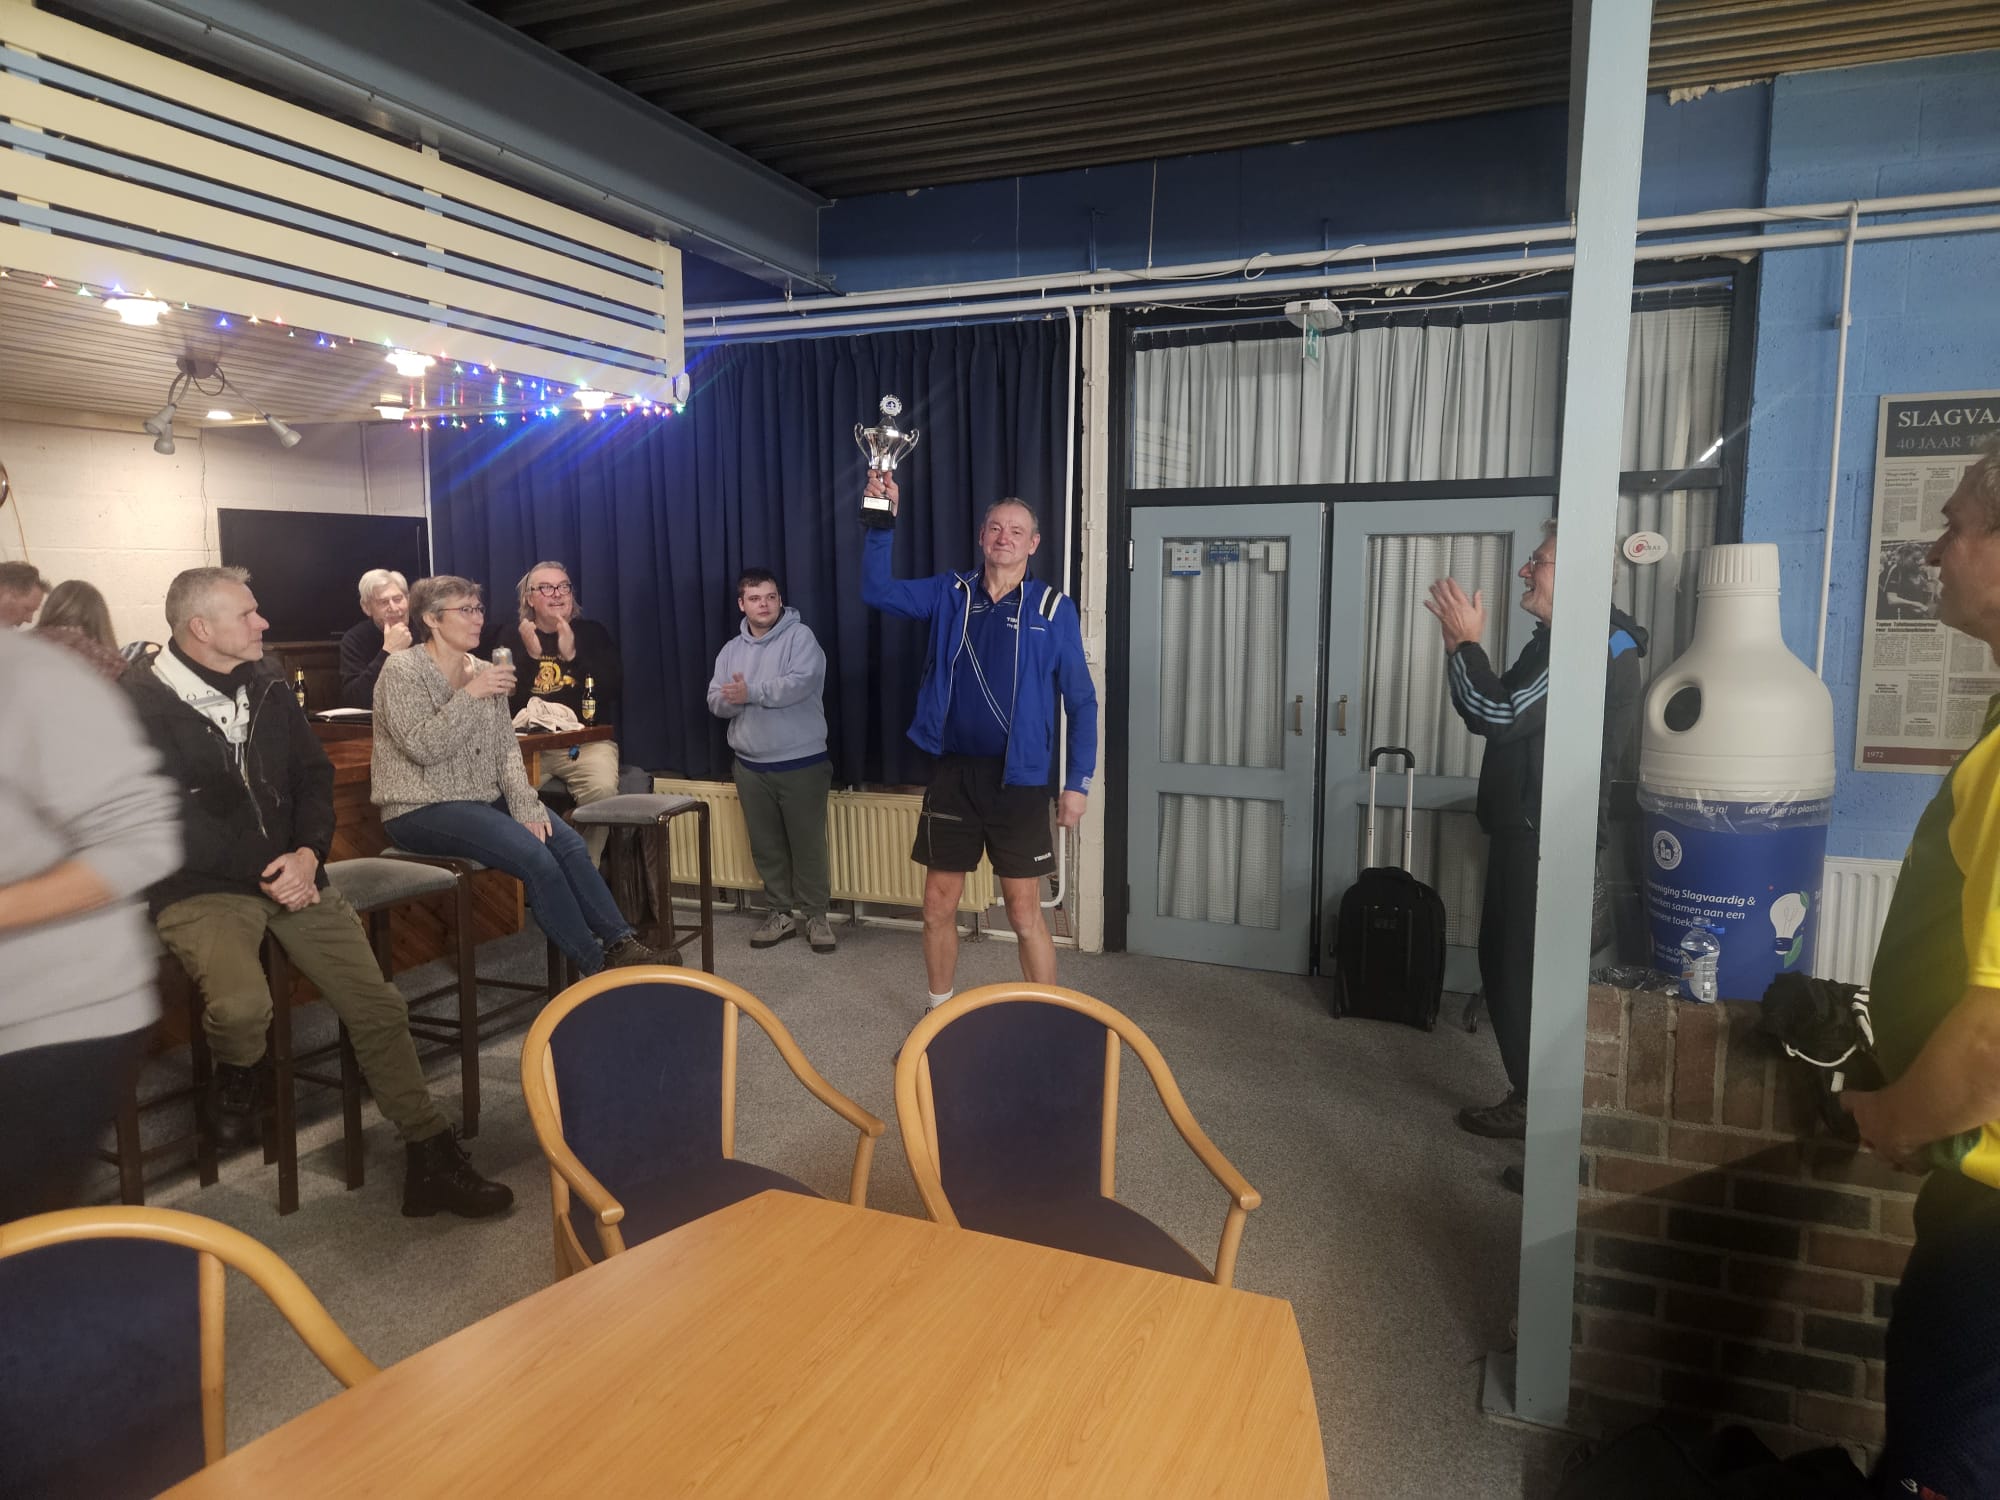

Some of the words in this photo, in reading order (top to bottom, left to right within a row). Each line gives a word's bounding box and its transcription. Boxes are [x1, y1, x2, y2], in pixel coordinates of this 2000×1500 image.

[1896, 438, 1914, 449] 40
[1918, 436, 1960, 449] JAAR
[1866, 751, 1884, 759] 1972
[1744, 805, 1771, 815] Lever
[1682, 889, 1746, 907] Slagvaardig
[1747, 896, 1756, 906] &
[1672, 902, 1702, 915] samen
[1703, 909, 1724, 919] aan
[1726, 911, 1745, 920] een
